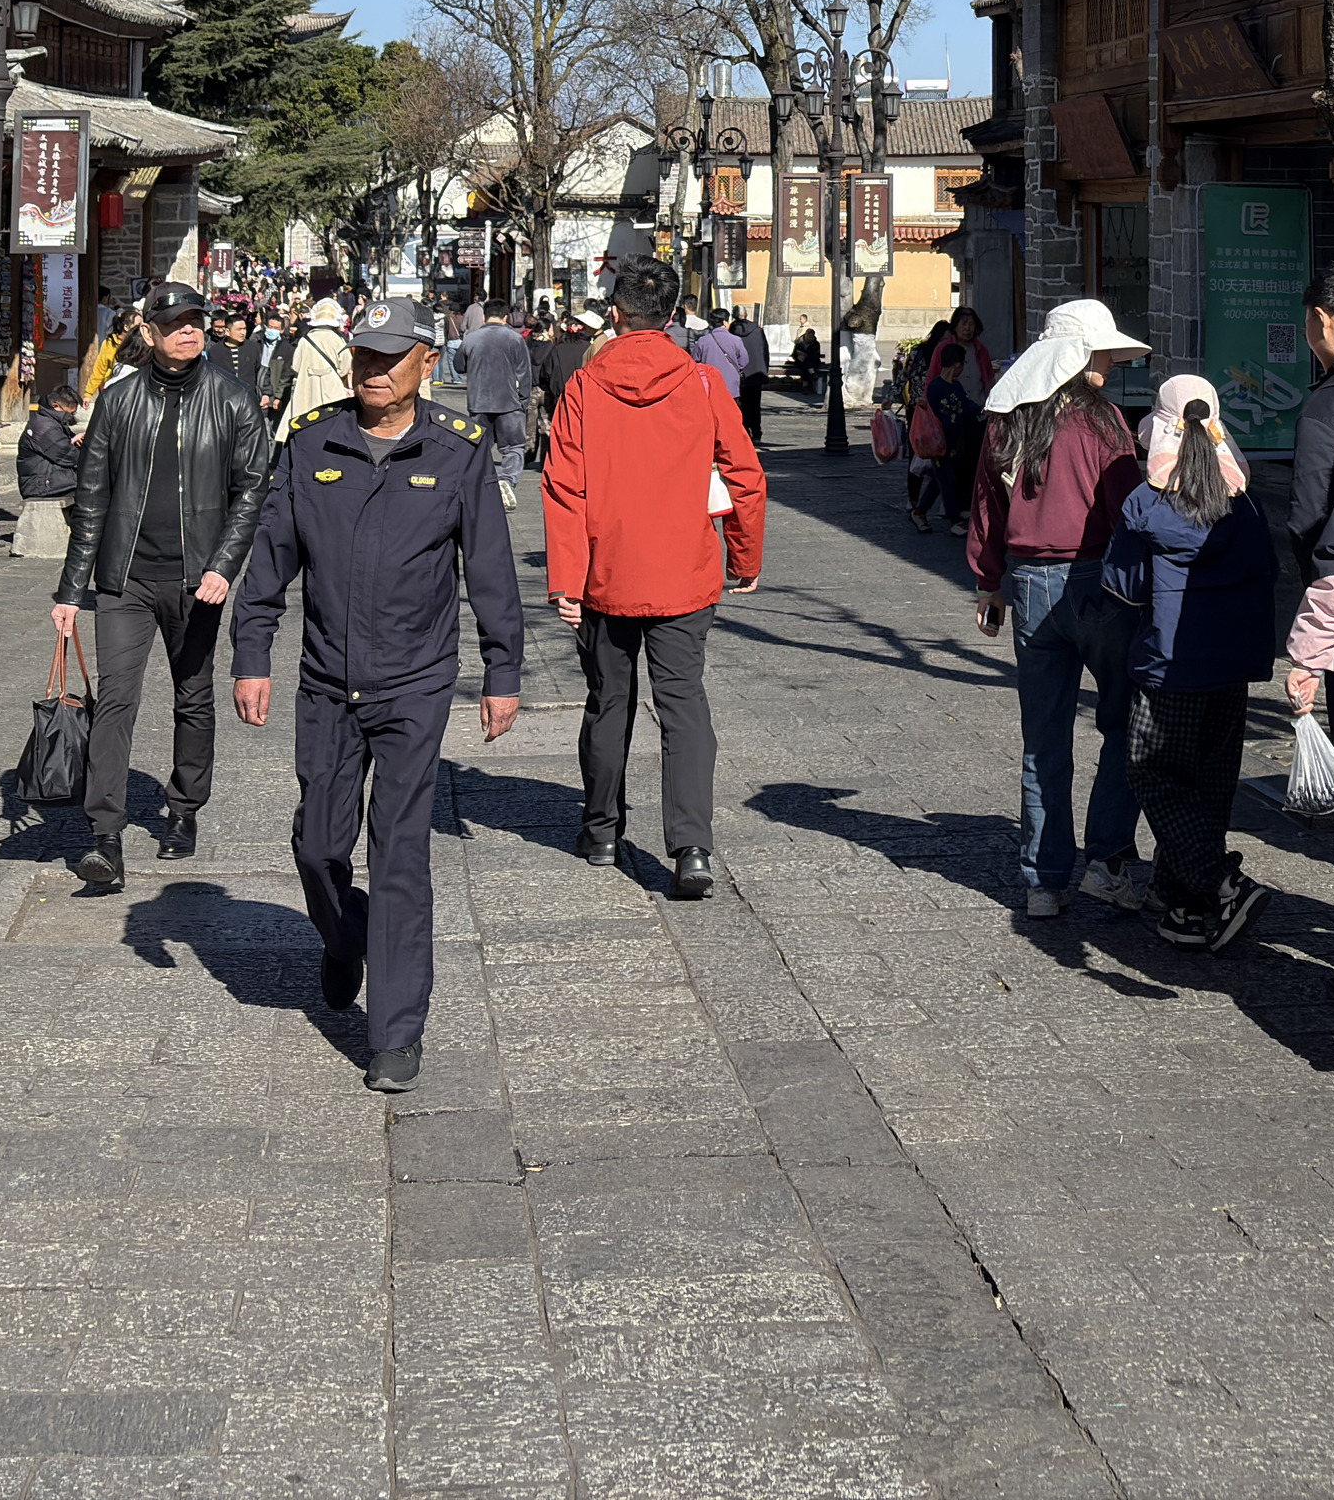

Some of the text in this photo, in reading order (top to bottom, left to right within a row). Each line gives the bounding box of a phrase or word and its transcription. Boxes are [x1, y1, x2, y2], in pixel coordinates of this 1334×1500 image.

[1209, 278, 1304, 294] 30天无理由退货
